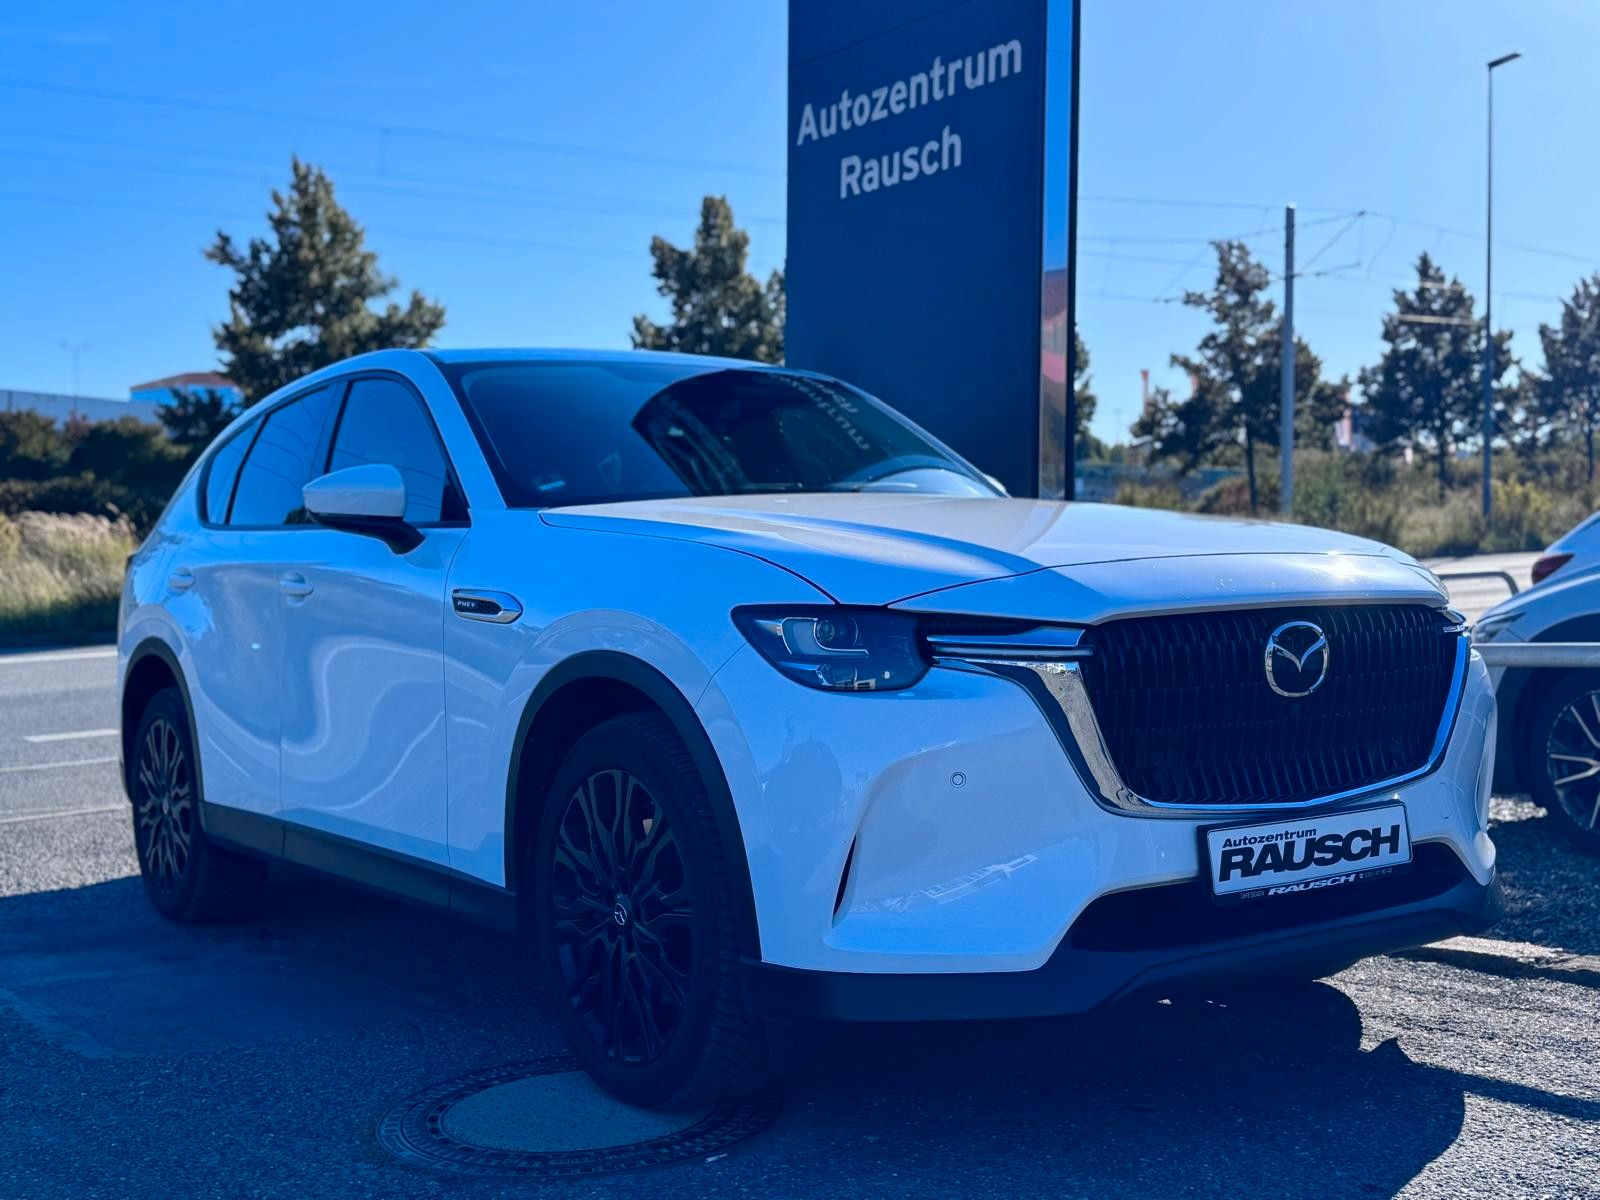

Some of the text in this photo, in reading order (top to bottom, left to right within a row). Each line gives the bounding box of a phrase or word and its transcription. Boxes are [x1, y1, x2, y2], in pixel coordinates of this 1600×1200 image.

[797, 39, 1022, 146] Autozentrum
[840, 125, 962, 200] Rausch
[1218, 824, 1400, 882] RAUSCH
[1222, 828, 1317, 849] Autozentrum
[1268, 874, 1357, 896] RAUSCH
